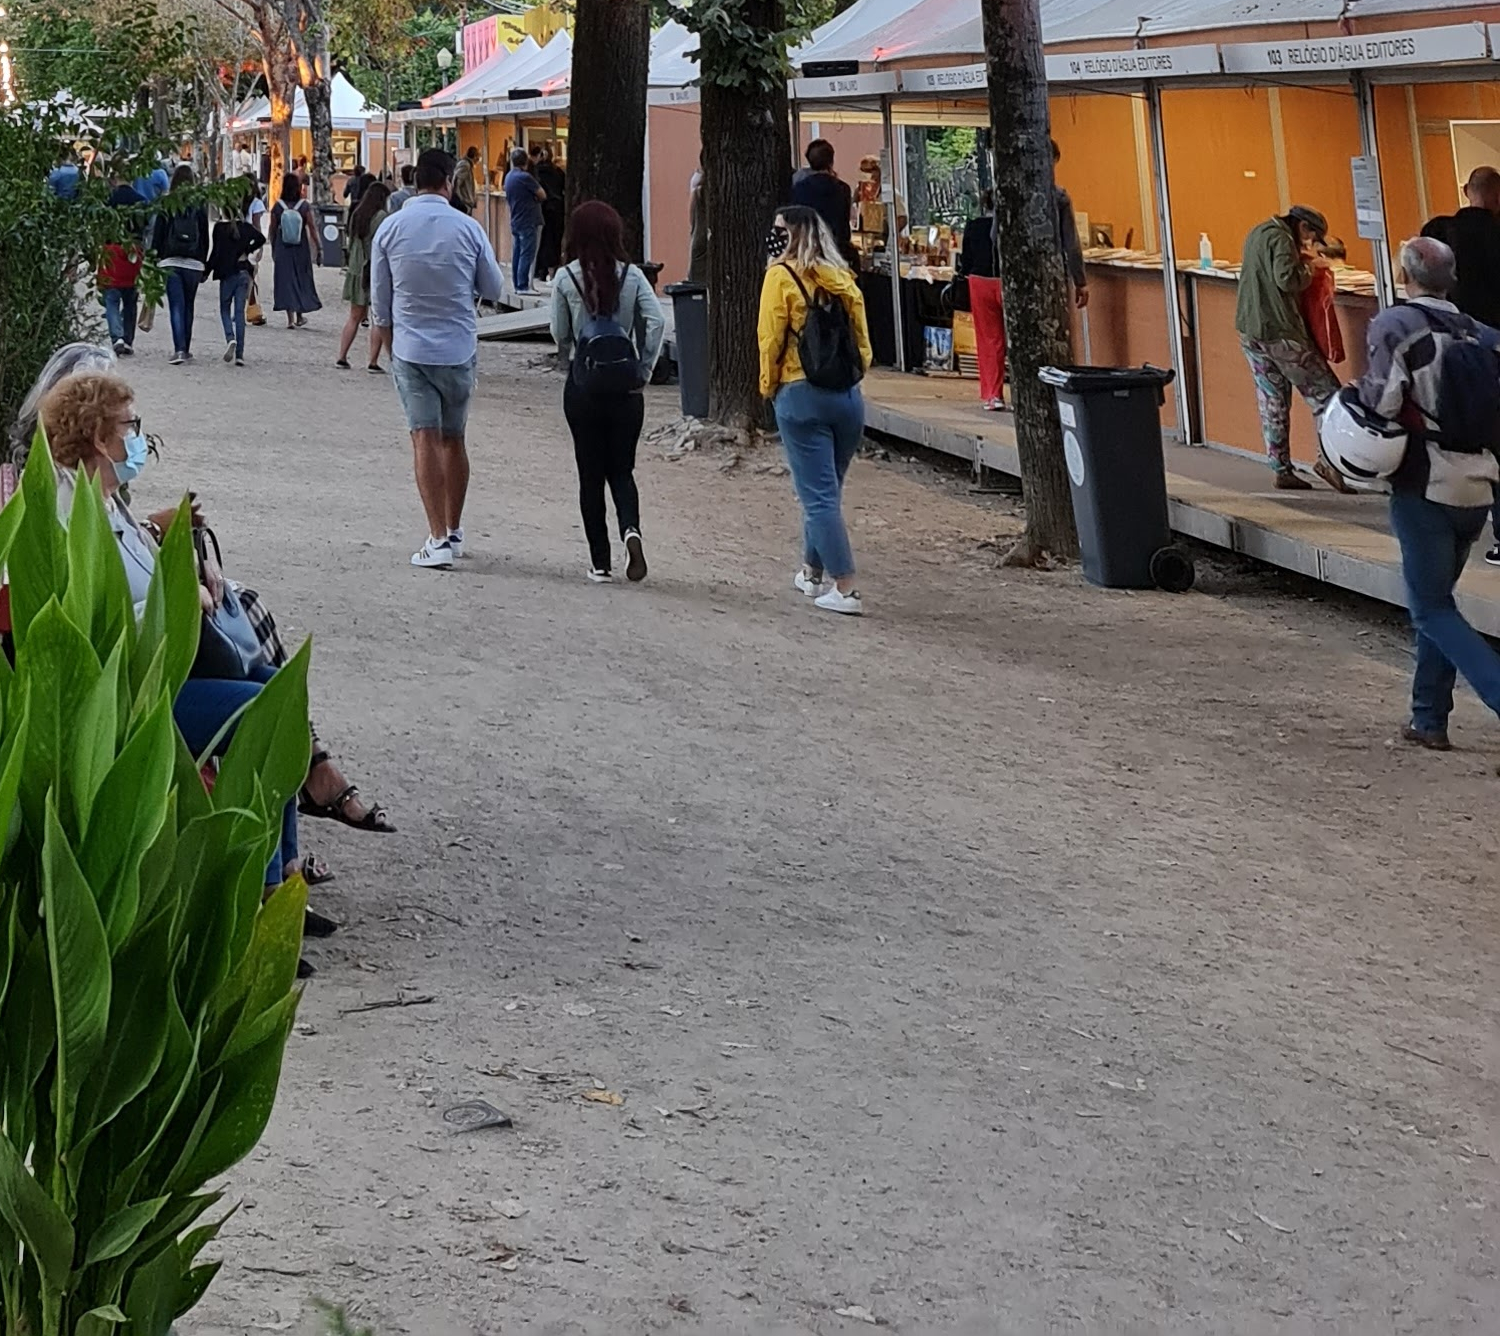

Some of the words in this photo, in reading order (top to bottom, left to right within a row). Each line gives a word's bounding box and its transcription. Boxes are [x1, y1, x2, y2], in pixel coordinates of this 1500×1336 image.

[1267, 49, 1283, 65] 103
[1287, 43, 1328, 64] RELÓGIO
[1329, 41, 1364, 63] D'ÁGUA
[1366, 38, 1416, 58] EDITORES
[1070, 61, 1081, 74] 104
[1084, 56, 1111, 74] RELÓGIO
[1138, 55, 1173, 72] EDITORES
